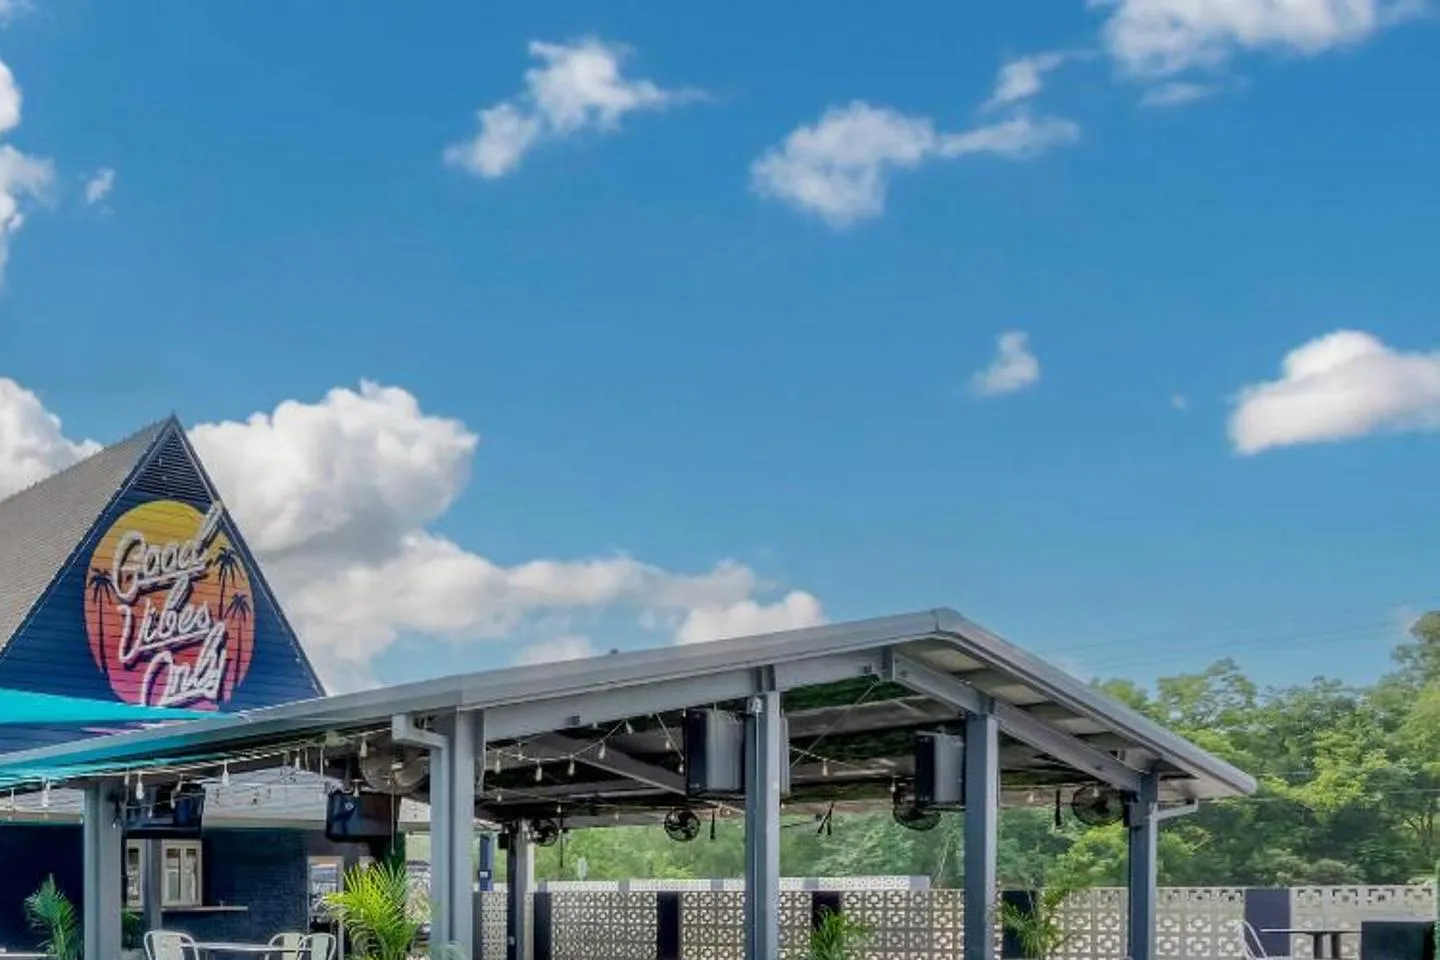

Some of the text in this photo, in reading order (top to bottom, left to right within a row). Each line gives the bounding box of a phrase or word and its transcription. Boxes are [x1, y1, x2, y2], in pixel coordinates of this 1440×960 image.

[113, 502, 222, 602] Good
[117, 576, 215, 662] Vibes
[141, 620, 228, 706] Only
